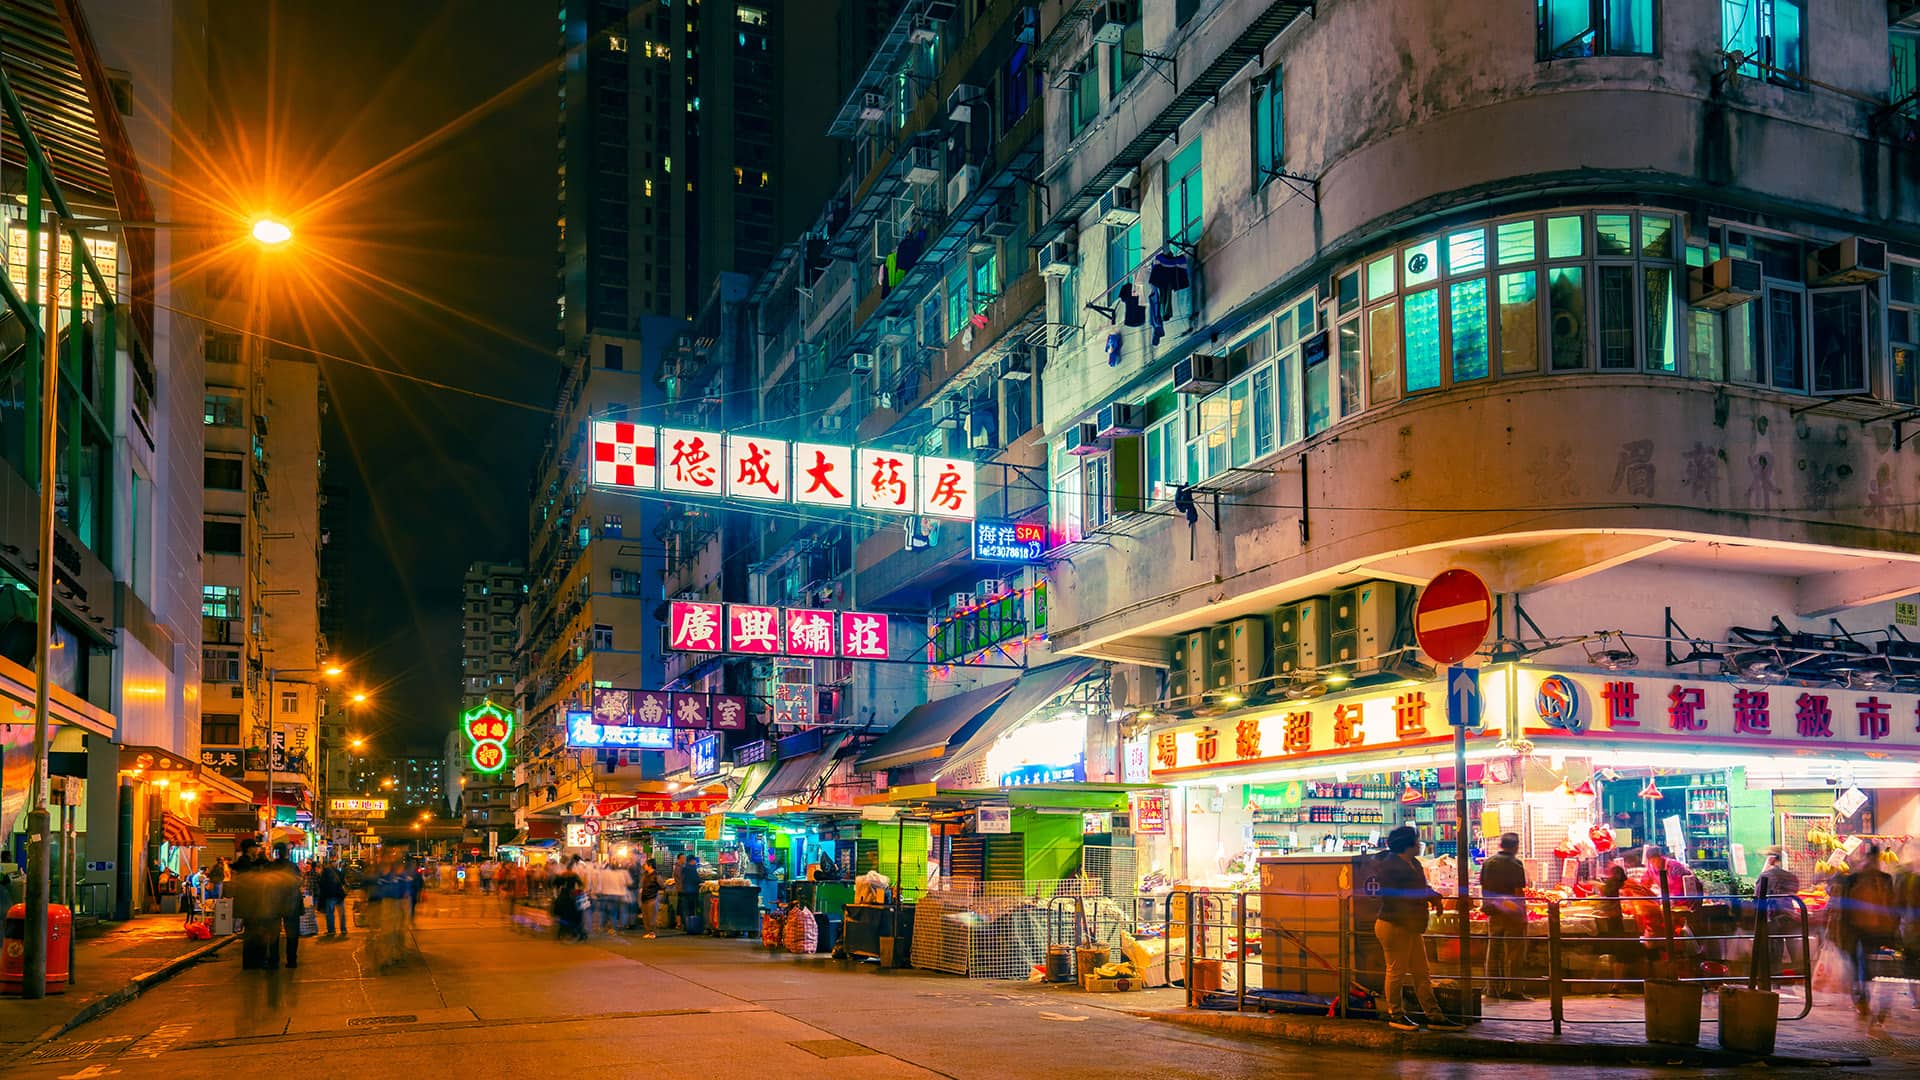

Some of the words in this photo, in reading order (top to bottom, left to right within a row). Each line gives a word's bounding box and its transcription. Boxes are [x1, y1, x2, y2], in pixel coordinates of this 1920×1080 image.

[978, 524, 1015, 545] 海洋
[1017, 528, 1041, 540] SPA
[598, 690, 741, 727] 華南冰室
